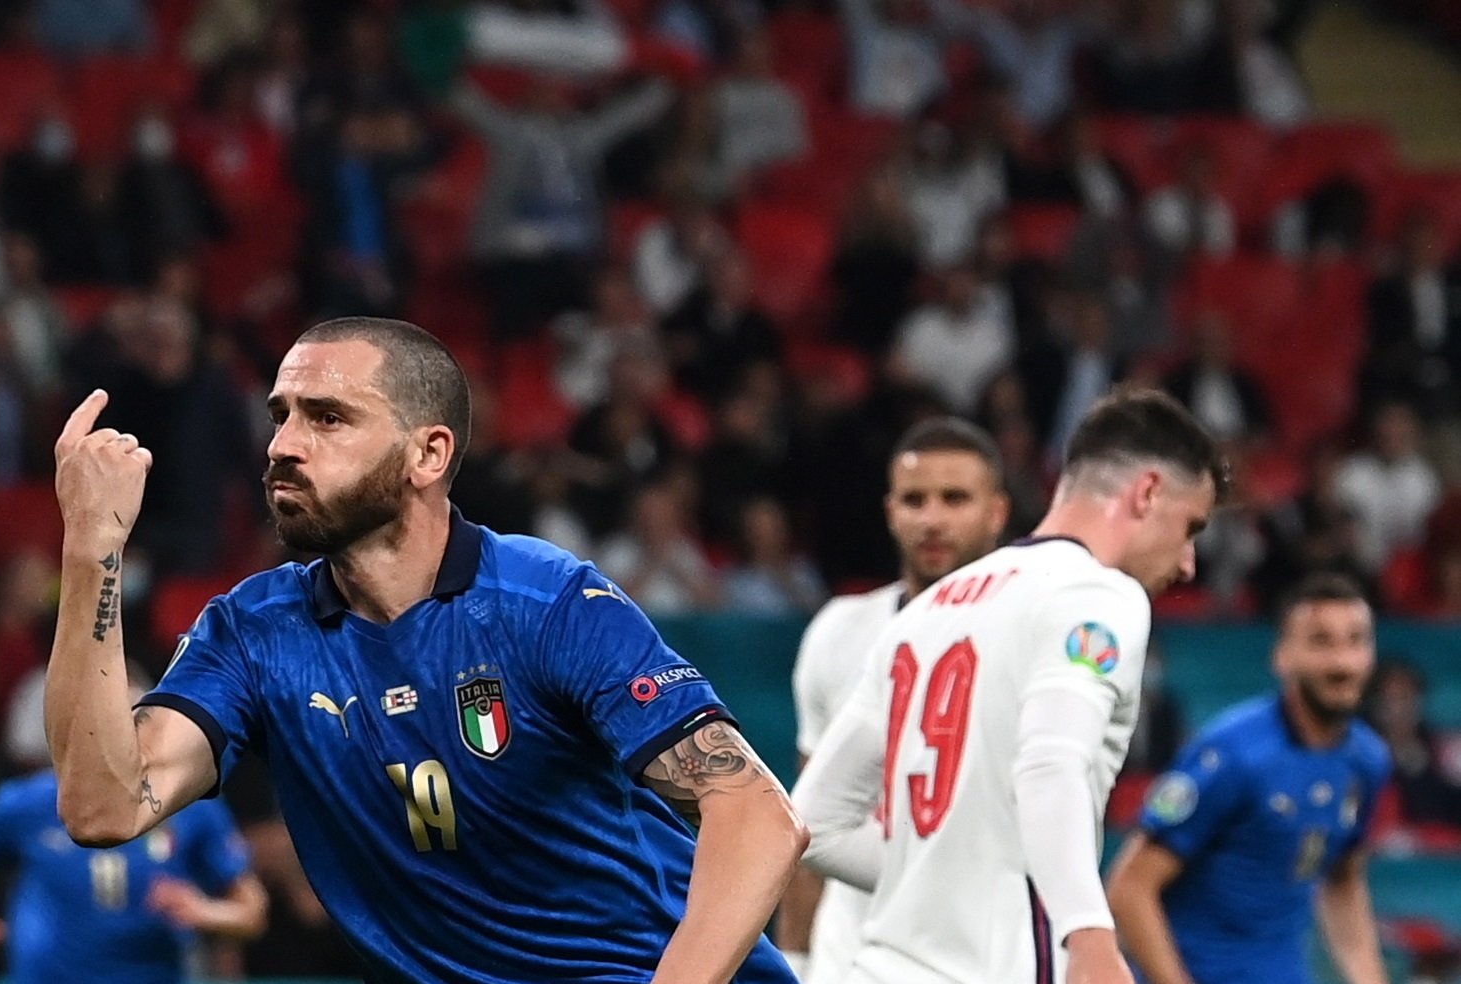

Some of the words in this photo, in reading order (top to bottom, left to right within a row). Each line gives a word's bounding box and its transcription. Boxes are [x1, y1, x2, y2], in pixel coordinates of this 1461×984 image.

[460, 683, 500, 702] ITALIA
[875, 636, 979, 841] 19
[385, 759, 457, 853] 19
